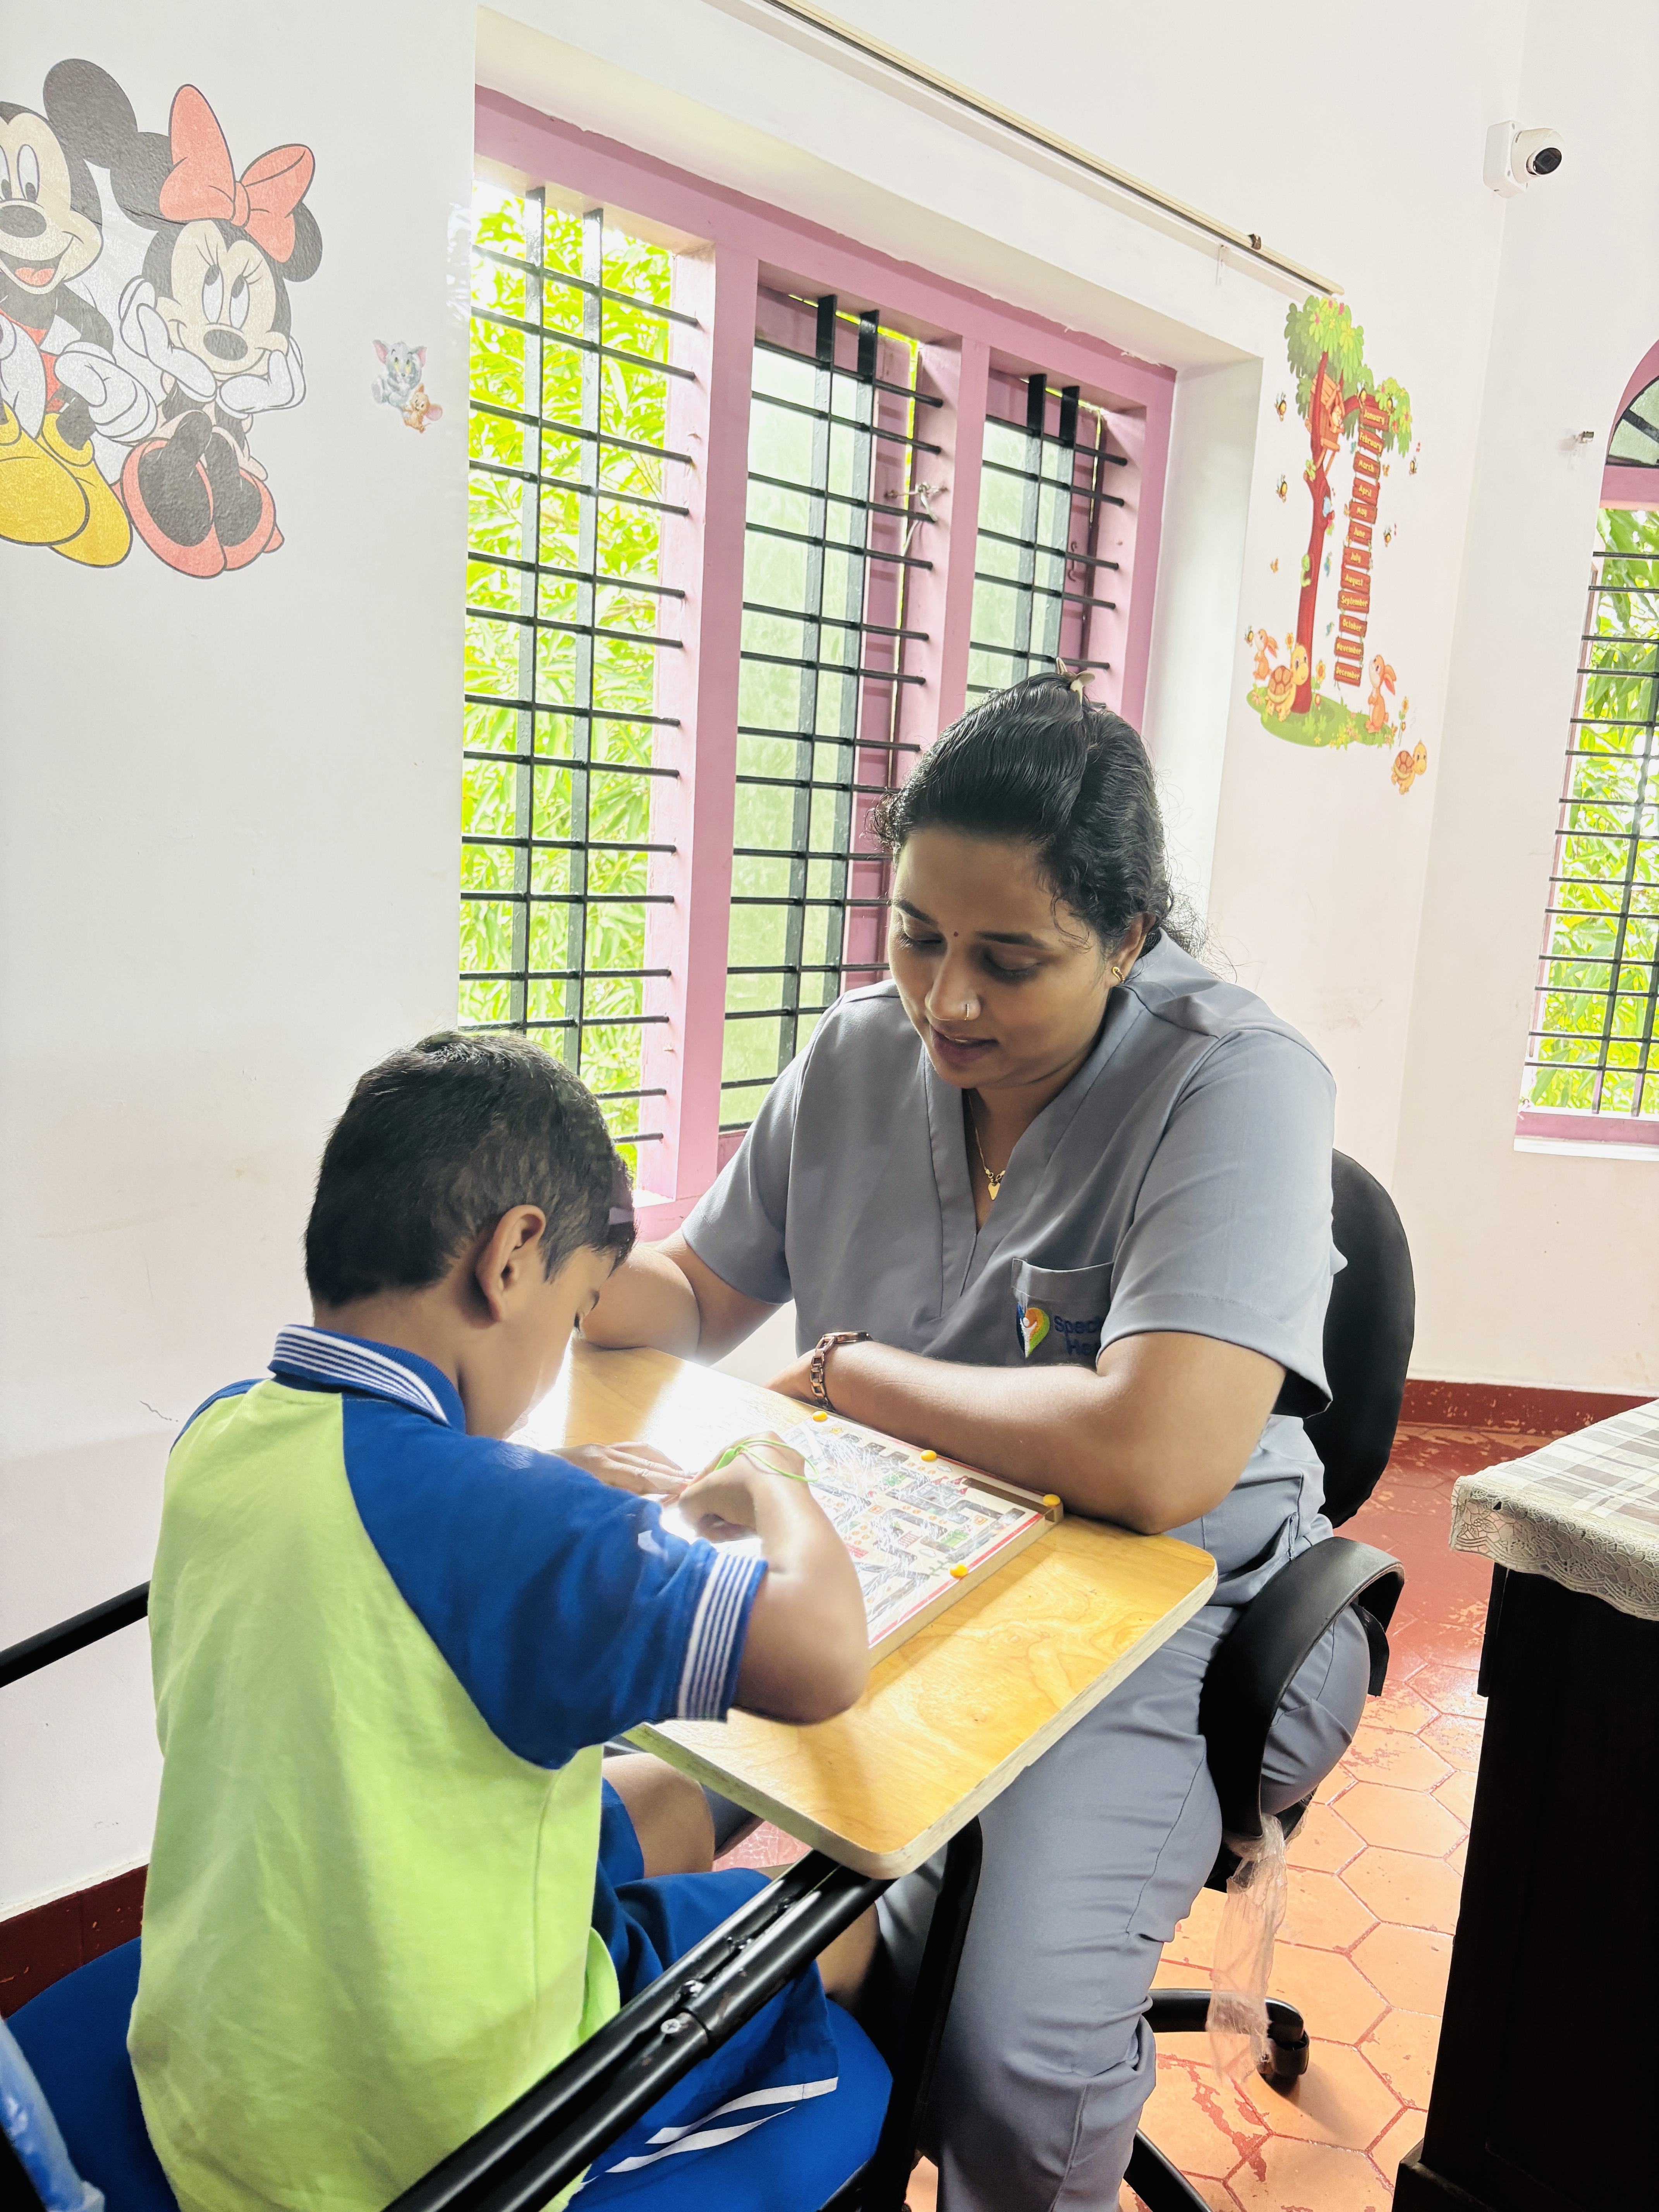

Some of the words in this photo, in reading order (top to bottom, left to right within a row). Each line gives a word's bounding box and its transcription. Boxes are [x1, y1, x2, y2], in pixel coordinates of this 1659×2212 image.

[1364, 409, 1384, 425] January
[1359, 431, 1382, 452] February
[1358, 459, 1374, 473] March
[1358, 484, 1372, 498] April
[1356, 507, 1367, 517] May
[1353, 527, 1365, 538] June
[1350, 552, 1361, 563] July
[1345, 574, 1363, 587] August
[1341, 595, 1368, 607] September
[1342, 618, 1362, 632] October
[1336, 642, 1362, 655] November
[1336, 666, 1360, 680] December
